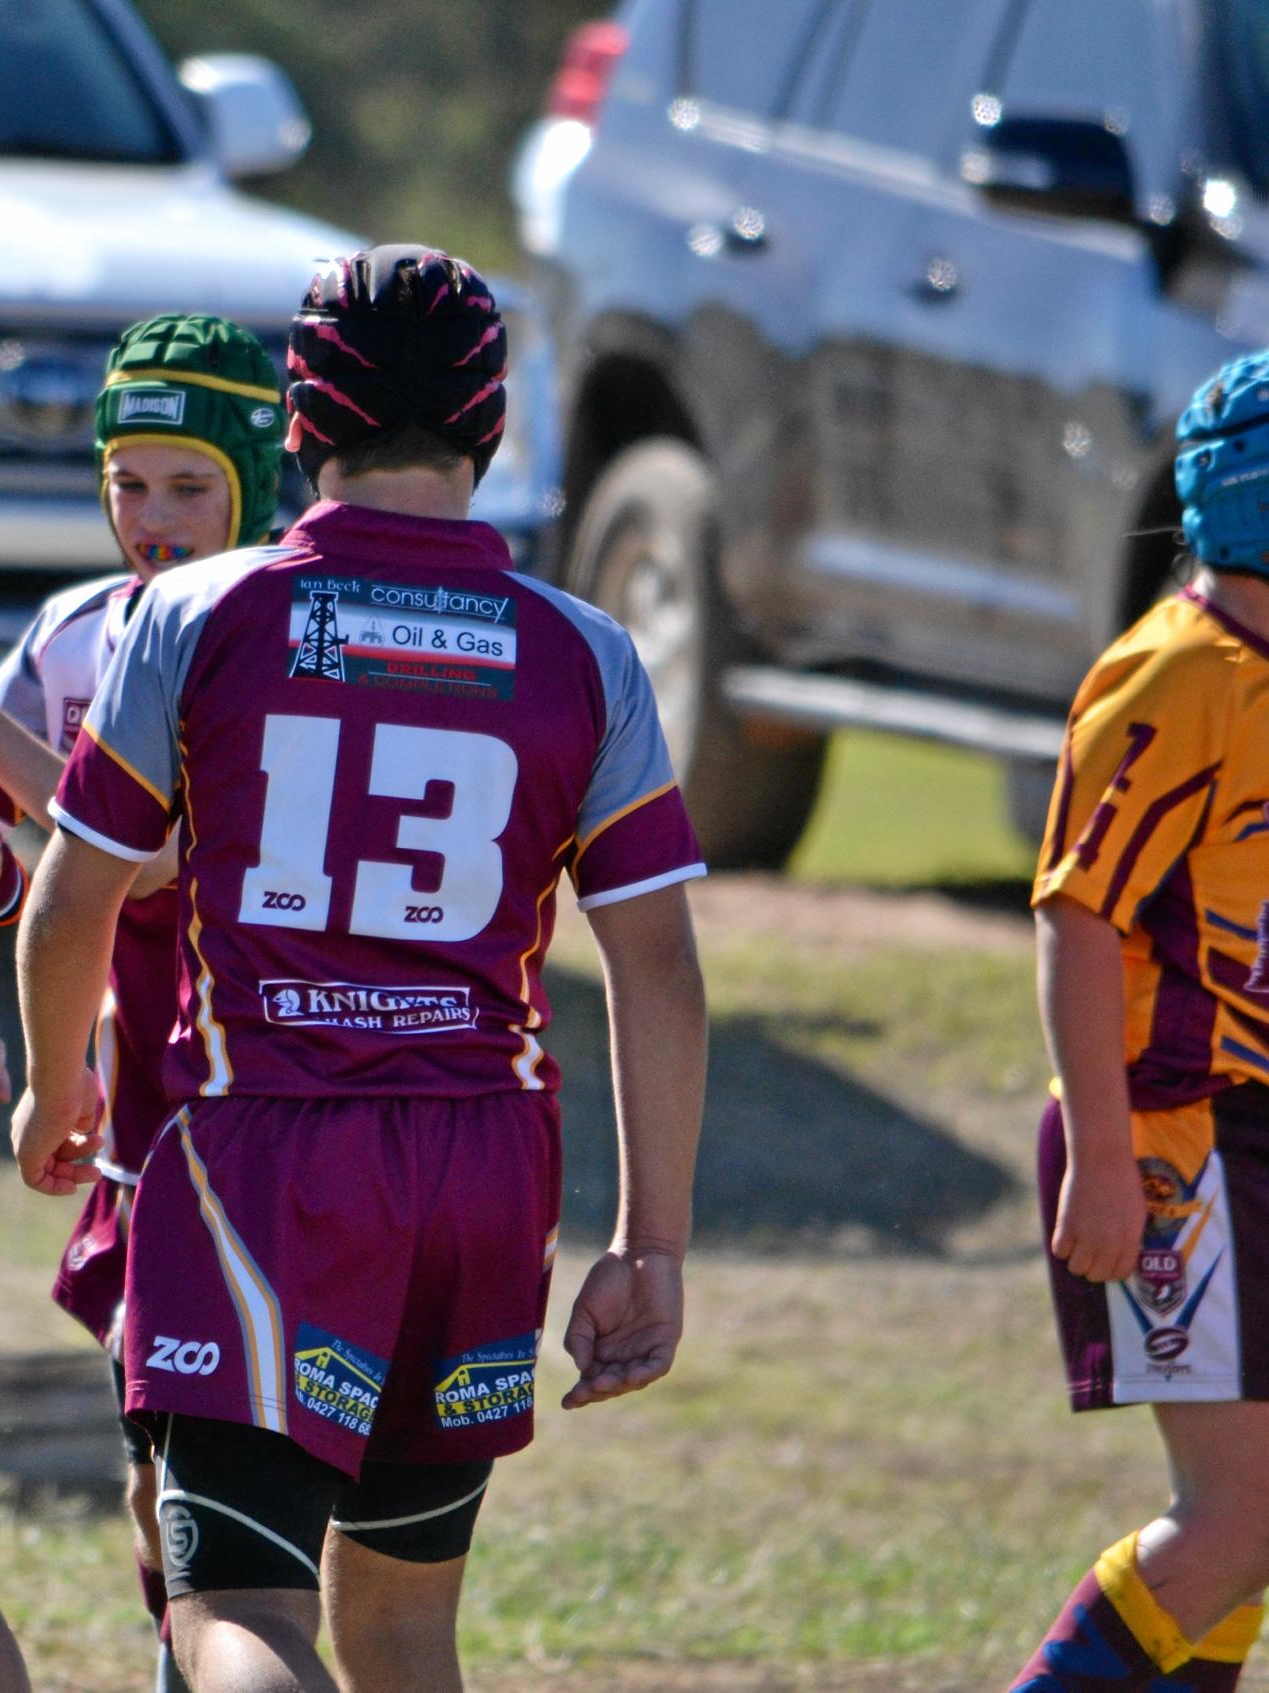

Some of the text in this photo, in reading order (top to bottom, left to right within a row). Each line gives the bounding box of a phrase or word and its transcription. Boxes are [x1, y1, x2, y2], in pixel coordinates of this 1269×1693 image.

[122, 394, 180, 421] MADISON
[370, 585, 509, 624] consultancy
[392, 625, 504, 657] Oil & Gas
[386, 662, 476, 680] DRILLING
[237, 713, 519, 943] 13
[319, 1007, 471, 1029] MASH REPAIRS
[1141, 1256, 1177, 1272] QLD
[435, 1370, 535, 1404] ROMA SPA
[306, 1397, 337, 1418] 0427
[338, 1412, 359, 1430] 118
[440, 1396, 533, 1428] Mob. 0427 118
